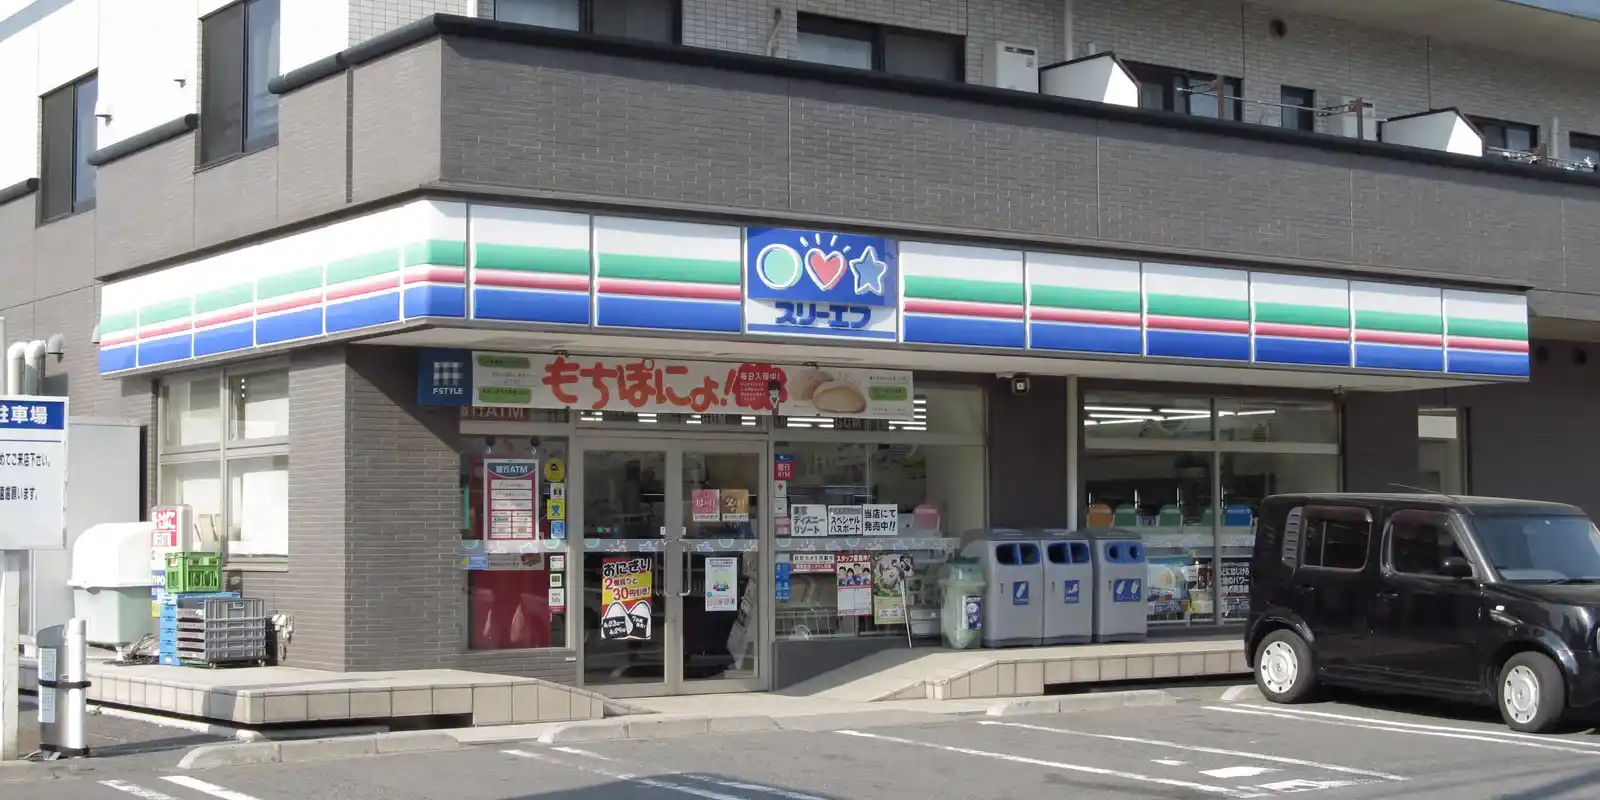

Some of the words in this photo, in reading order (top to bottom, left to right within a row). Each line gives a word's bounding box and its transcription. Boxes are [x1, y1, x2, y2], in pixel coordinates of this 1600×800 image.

[775, 302, 872, 328] スリーエフ
[541, 355, 736, 413] もちぽにょ!
[864, 509, 896, 519] 当店にて
[793, 516, 825, 525] ディズニー
[830, 515, 860, 525] スペシャル
[830, 525, 861, 533] パスポート
[864, 521, 896, 532] 発売中!!
[603, 559, 652, 577] おにぎり
